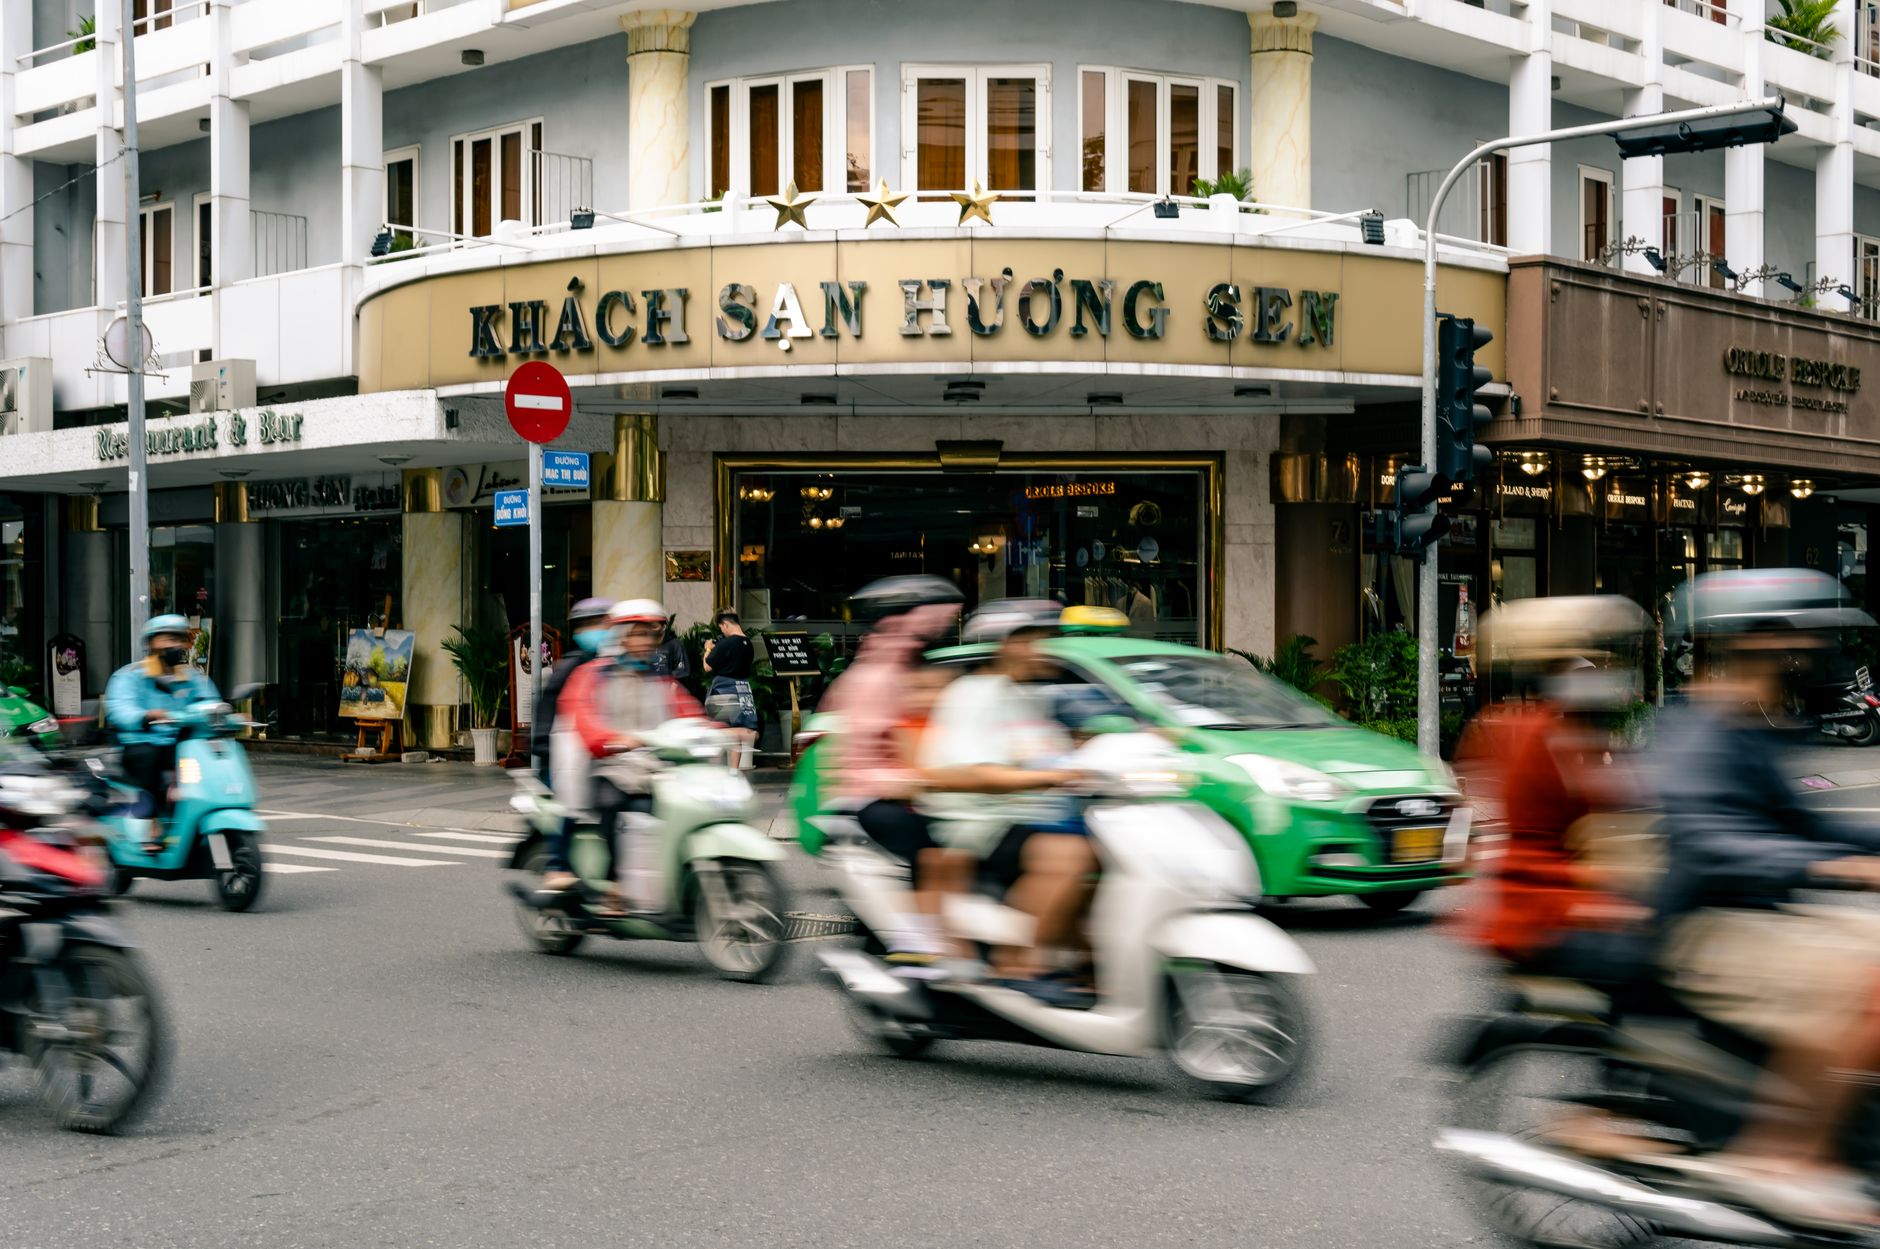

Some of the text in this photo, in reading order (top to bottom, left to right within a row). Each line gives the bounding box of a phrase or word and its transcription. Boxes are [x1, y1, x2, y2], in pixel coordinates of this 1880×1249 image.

[469, 267, 1339, 358] KHÁCH SẠN HƯƠNG SEN
[1724, 345, 1786, 383] ORIOLE
[95, 409, 303, 460] Resaurant & Bar
[1805, 546, 1820, 566] 62
